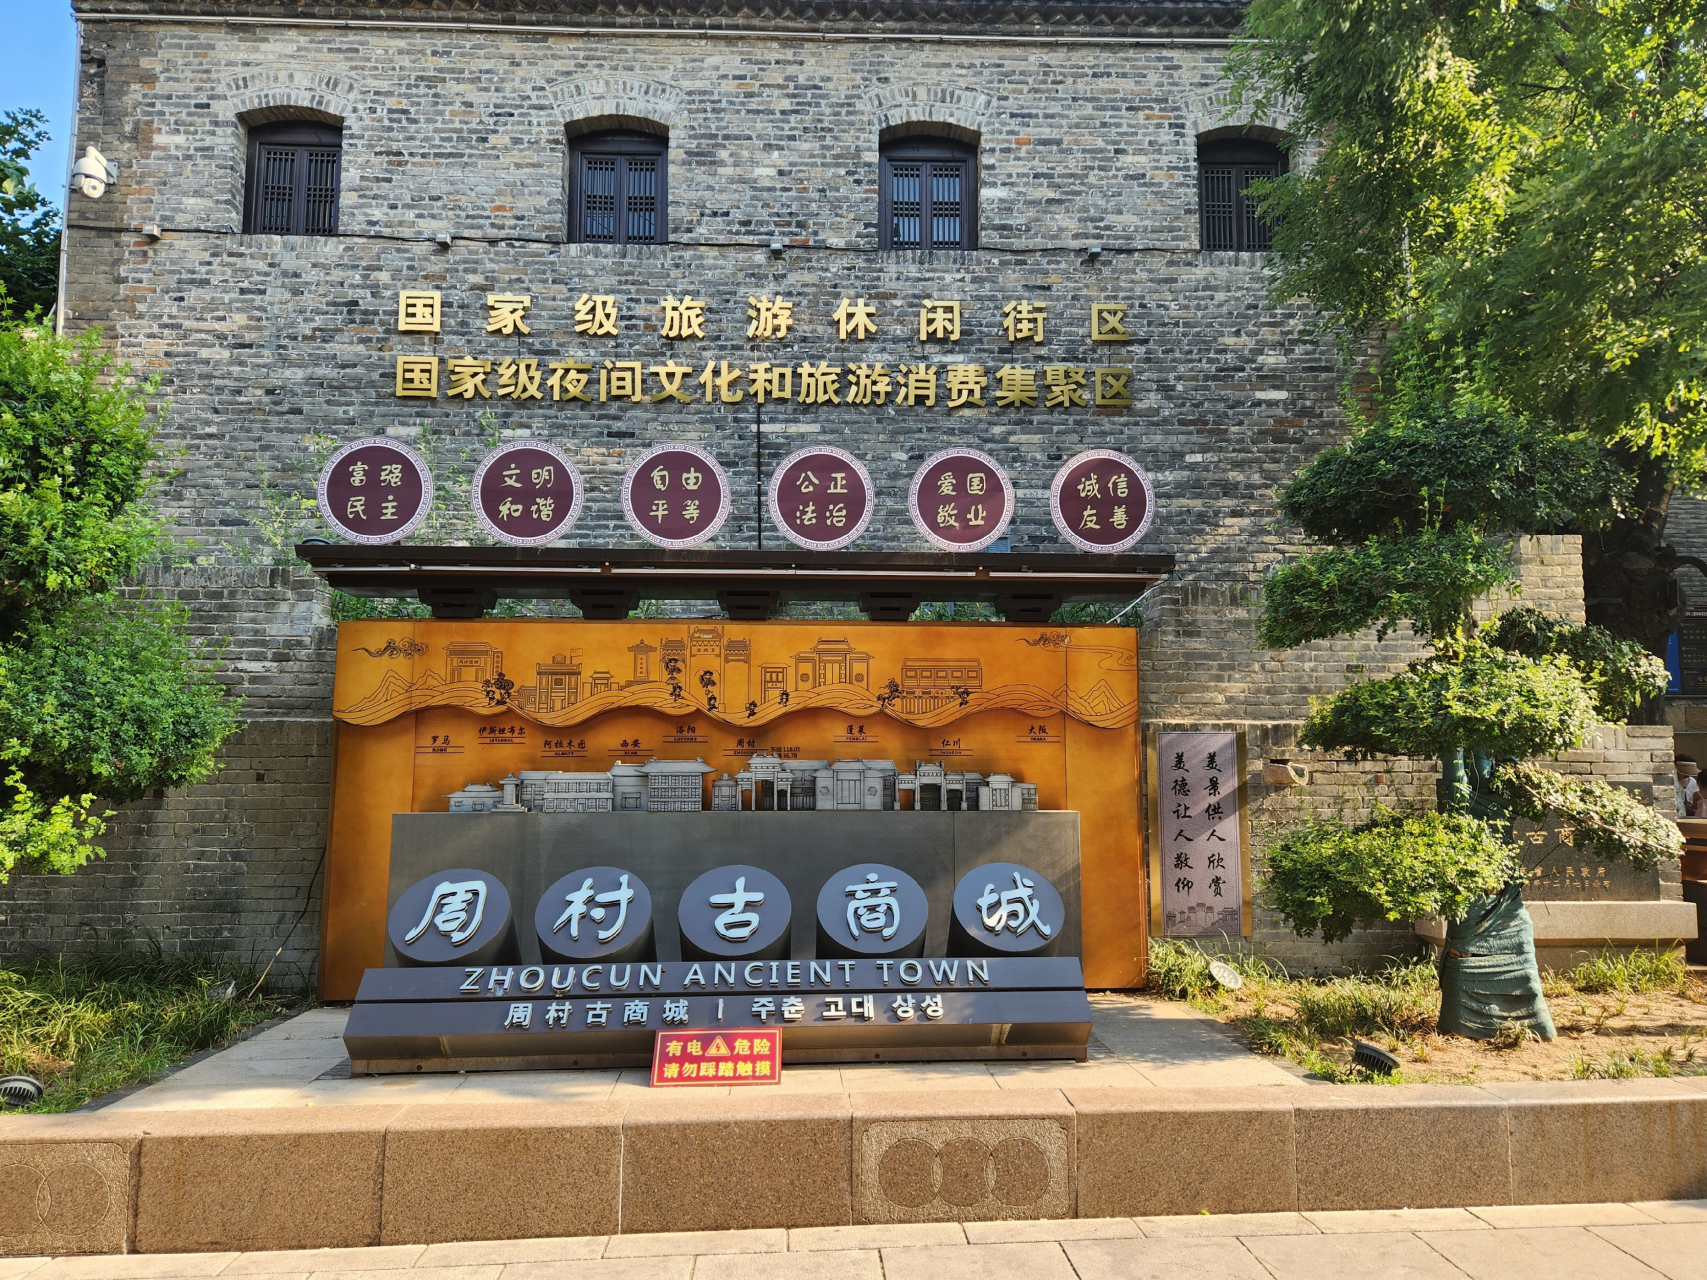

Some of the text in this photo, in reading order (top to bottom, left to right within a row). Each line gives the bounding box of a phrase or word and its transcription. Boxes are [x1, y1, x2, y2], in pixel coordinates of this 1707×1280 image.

[398, 291, 1130, 342] 国家级旅游休闲街区
[395, 355, 1134, 408] 国家级夜间文化和旅游消费集聚区
[348, 461, 402, 487] 富强
[501, 464, 554, 489] 文明
[650, 465, 702, 491] 自由
[796, 471, 848, 494] 公正
[937, 471, 986, 496] 爱国
[1077, 473, 1129, 499] 诚信
[347, 495, 399, 520] 民主
[498, 497, 555, 522] 和谐
[649, 499, 700, 524] 平等
[795, 501, 847, 527] 法治
[936, 502, 987, 528] 敬业
[1078, 504, 1129, 530] 友善
[431, 735, 451, 745] 罗马
[478, 725, 526, 736] 伊斯坦布尔
[675, 724, 696, 734] 洛阳
[846, 723, 867, 735] 蓬莱
[1028, 724, 1049, 735] 大阪
[543, 739, 586, 749] 阿拉木图
[620, 738, 641, 748] 西安
[736, 738, 756, 748] 周村
[941, 737, 961, 749] 仁川
[1171, 752, 1194, 897] 美德让人敬仰
[1203, 752, 1227, 897] 美景供人欣赏
[404, 871, 1051, 945] 周村古商城
[459, 958, 990, 993] ZHOUCUN ANCIENT TOWN
[504, 998, 689, 1029] 周村古商城
[751, 993, 944, 1023] 주춘 고대 상성
[665, 1038, 771, 1057] 有电 危险
[663, 1060, 772, 1079] 请勿踩踏触摸
